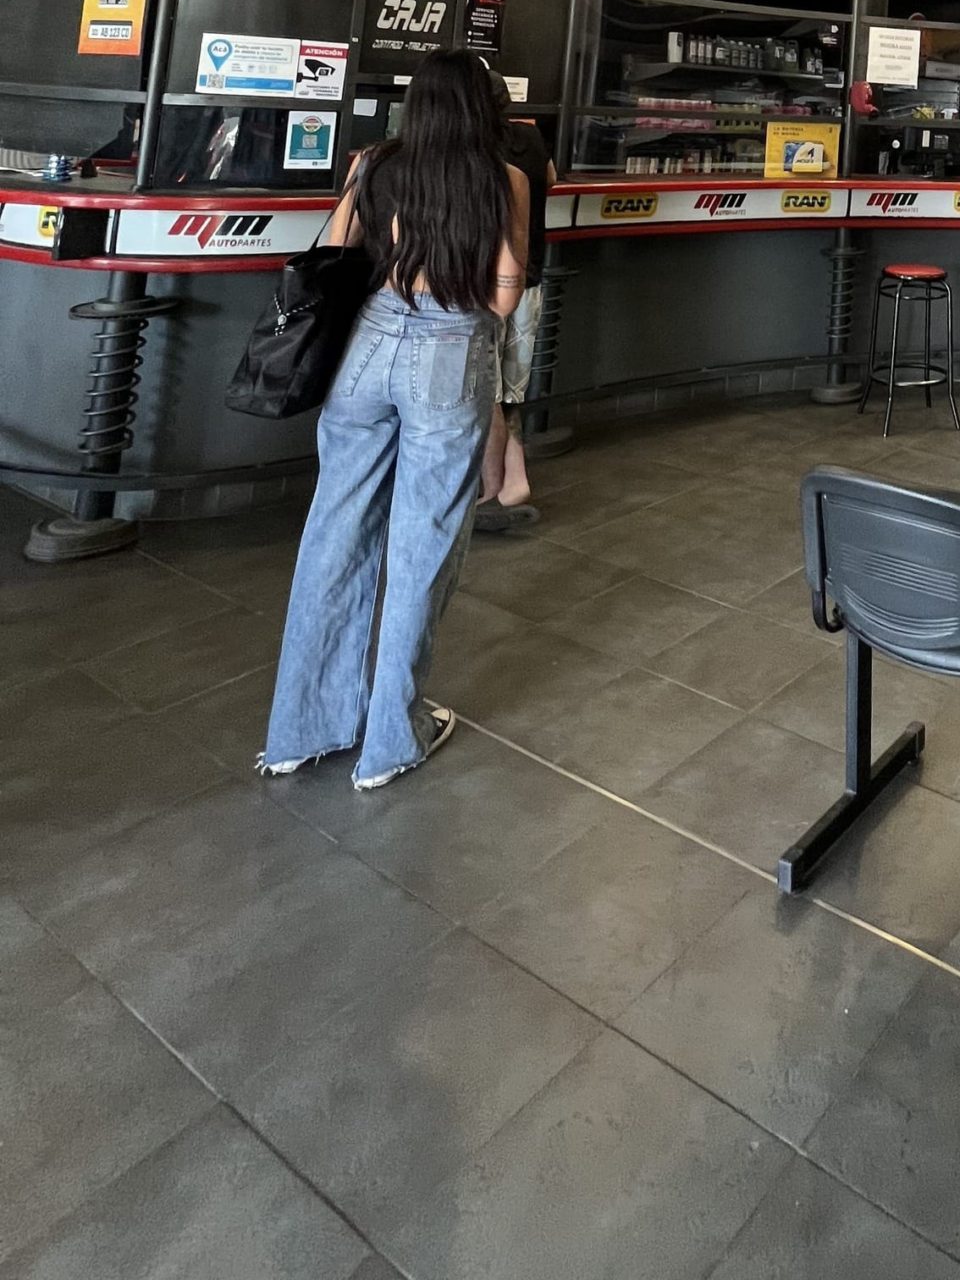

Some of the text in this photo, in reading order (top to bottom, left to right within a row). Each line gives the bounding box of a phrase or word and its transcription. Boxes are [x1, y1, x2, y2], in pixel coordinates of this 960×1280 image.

[305, 47, 343, 57] ATENCIÓN
[604, 199, 654, 213] RAN
[783, 196, 827, 208] RAN
[208, 238, 272, 248] AUTOPARTES
